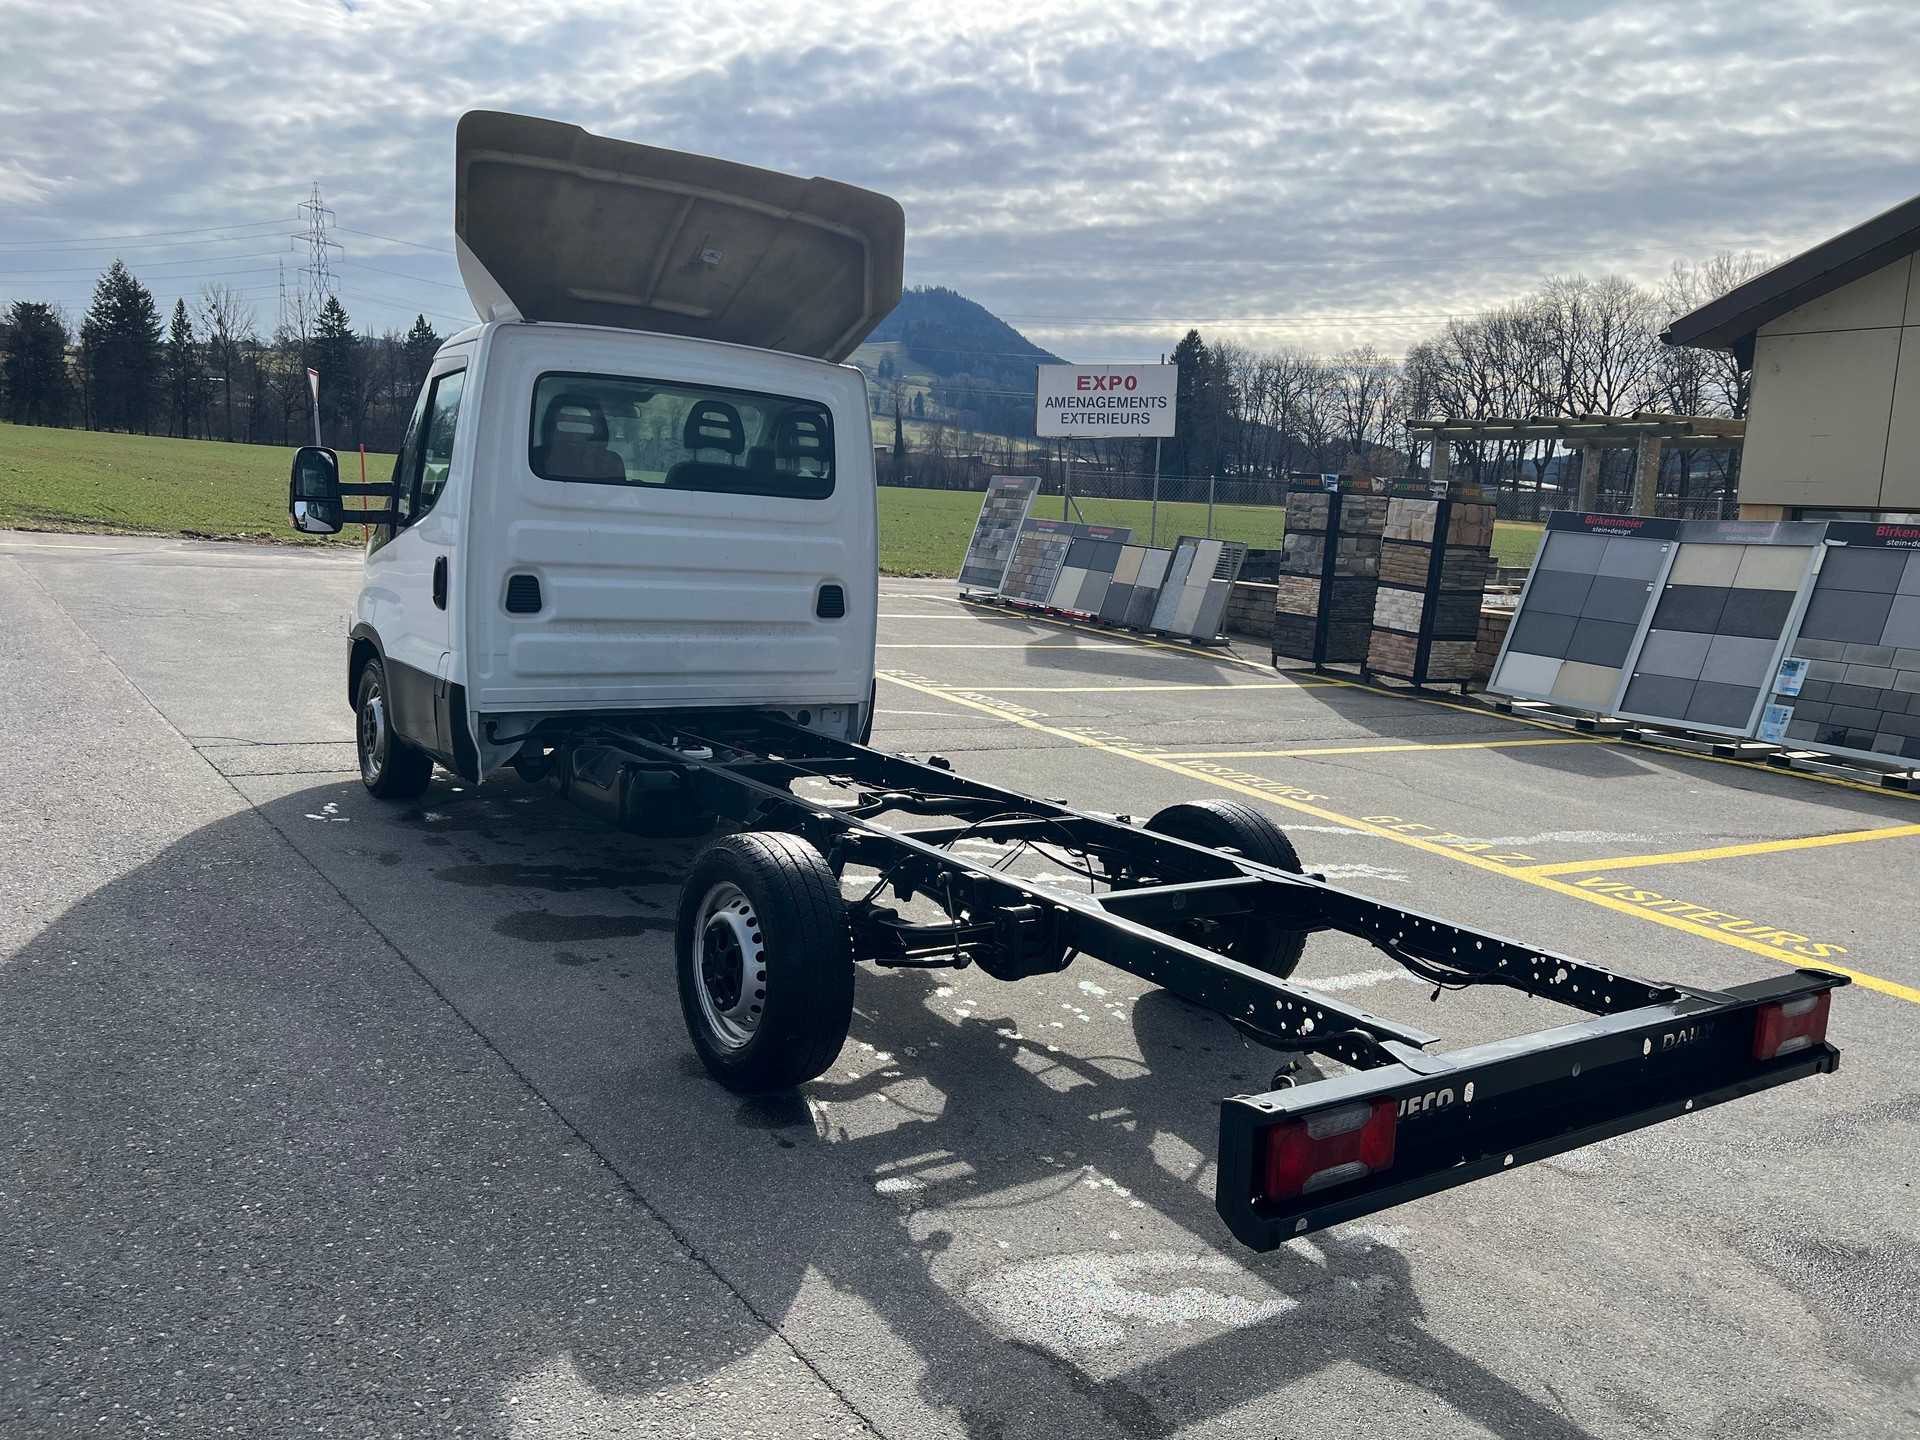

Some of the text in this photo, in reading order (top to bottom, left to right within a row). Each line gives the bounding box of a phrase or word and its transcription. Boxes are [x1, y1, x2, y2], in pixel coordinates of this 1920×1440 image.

[1077, 375, 1138, 391] EXPO
[1045, 396, 1167, 409] AMENAGEMENTS
[1060, 412, 1151, 425] EXTERIEURS
[1585, 515, 1645, 528] Birkenmeier
[1178, 760, 1538, 863] VISITEURS GETAZ
[1574, 876, 1849, 958] VISITEURS
[1396, 1087, 1455, 1118] VECO
